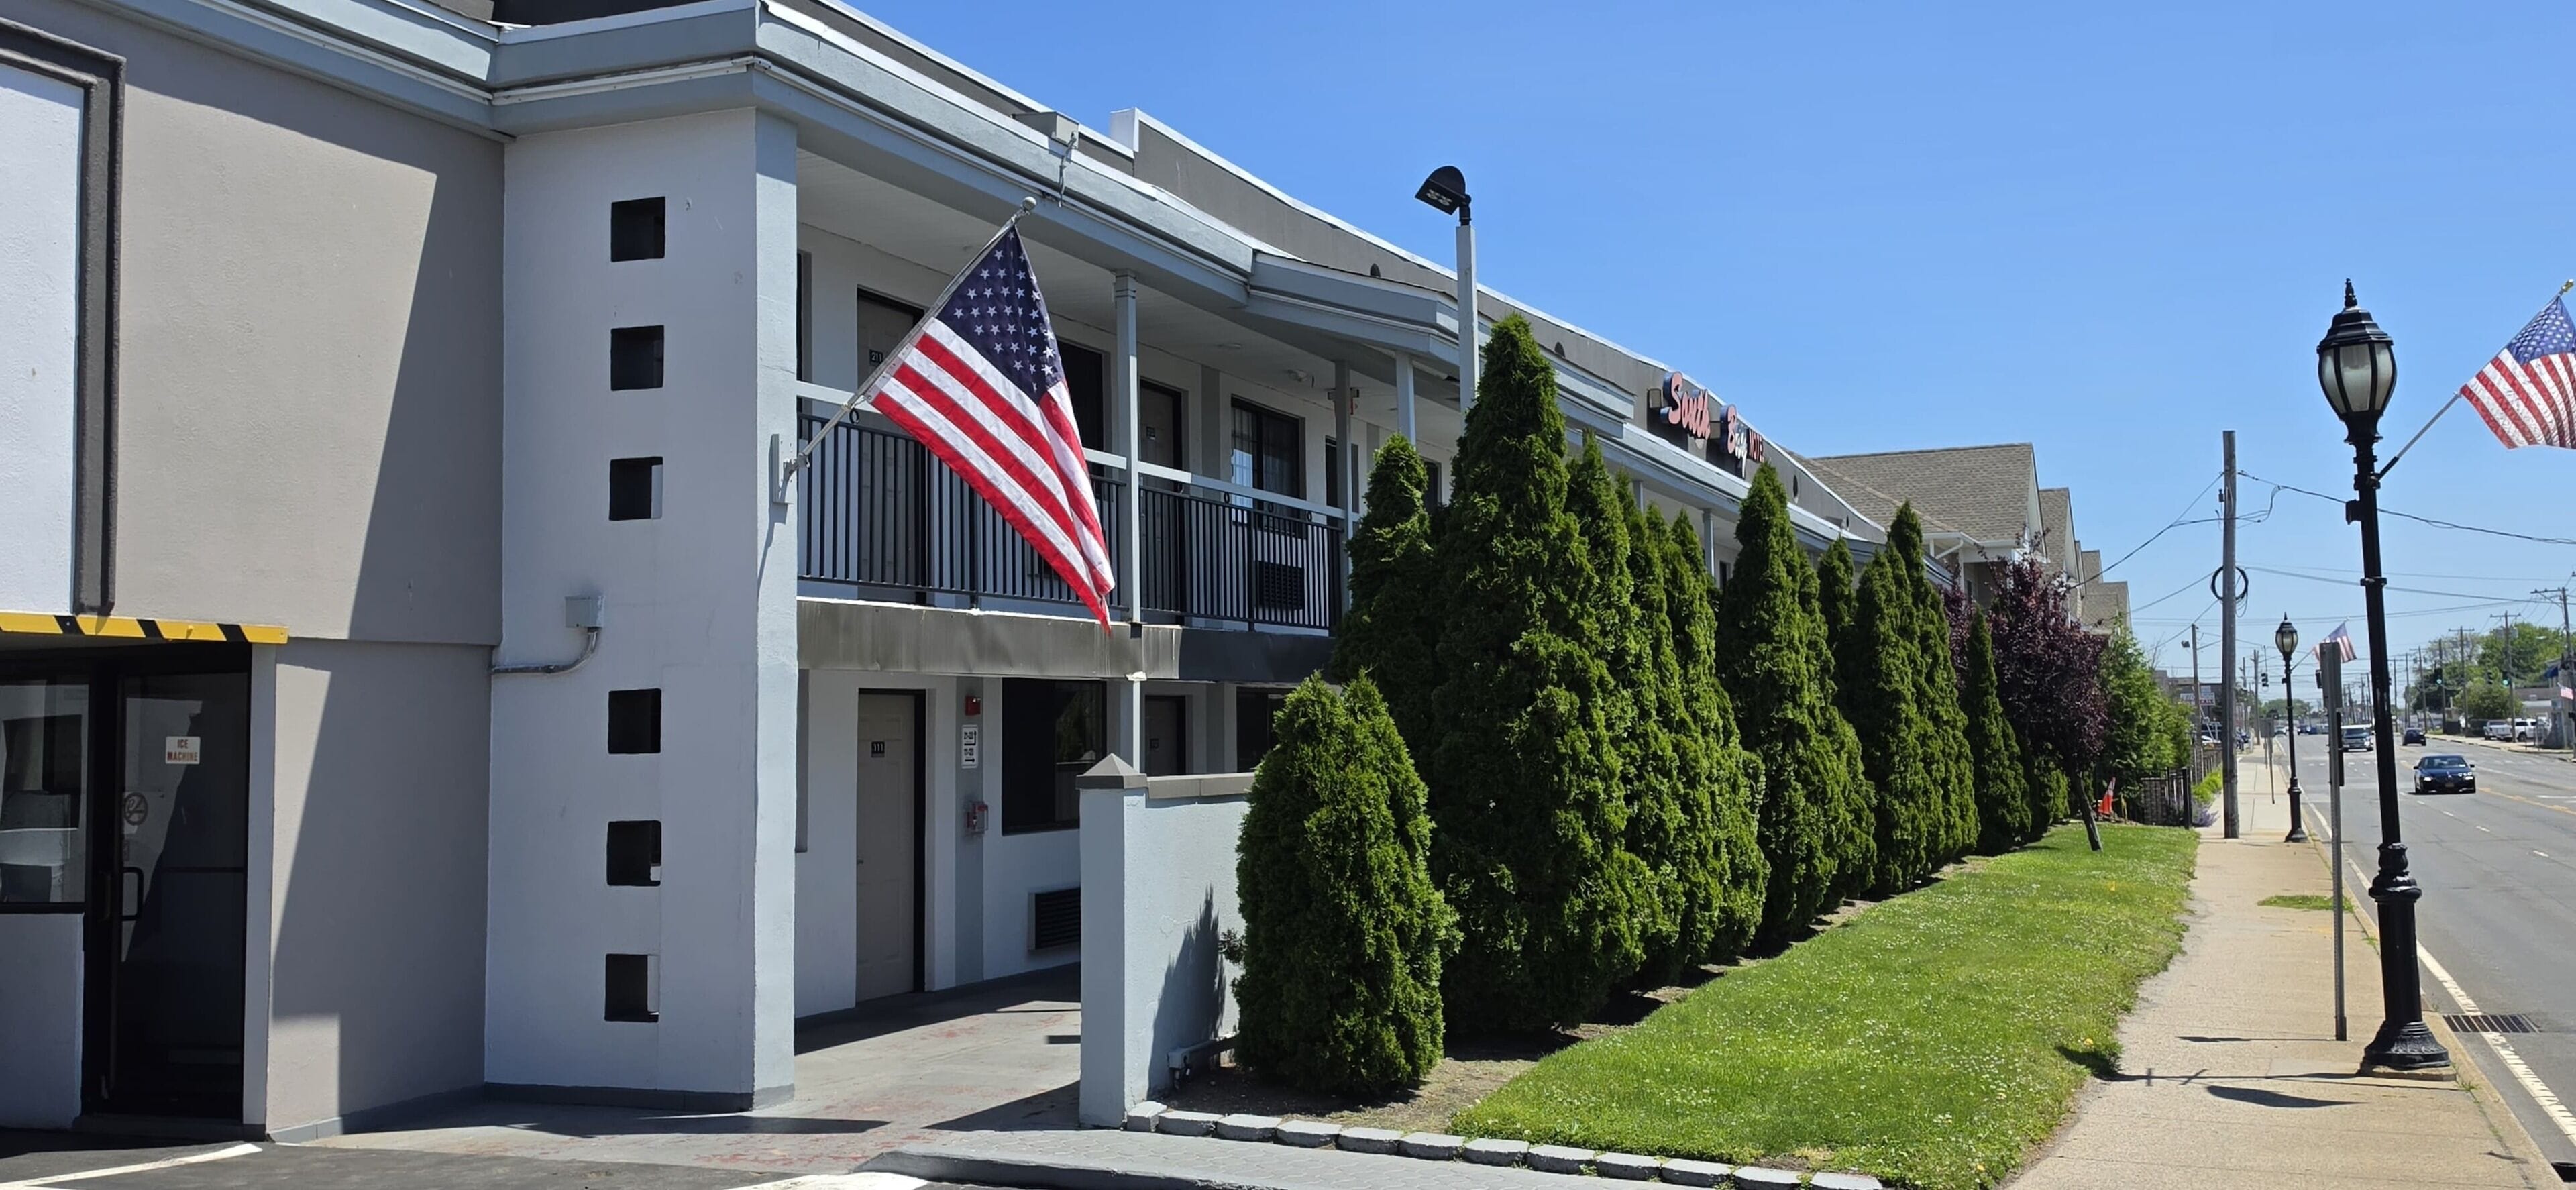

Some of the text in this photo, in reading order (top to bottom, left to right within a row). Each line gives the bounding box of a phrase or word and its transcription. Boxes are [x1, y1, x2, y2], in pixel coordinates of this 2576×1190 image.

[871, 351, 881, 362] 211
[1668, 372, 1711, 441] South
[1727, 404, 1748, 478] Bay
[177, 739, 189, 749] ICE
[873, 743, 883, 752] 111
[167, 751, 198, 762] MACHINE
